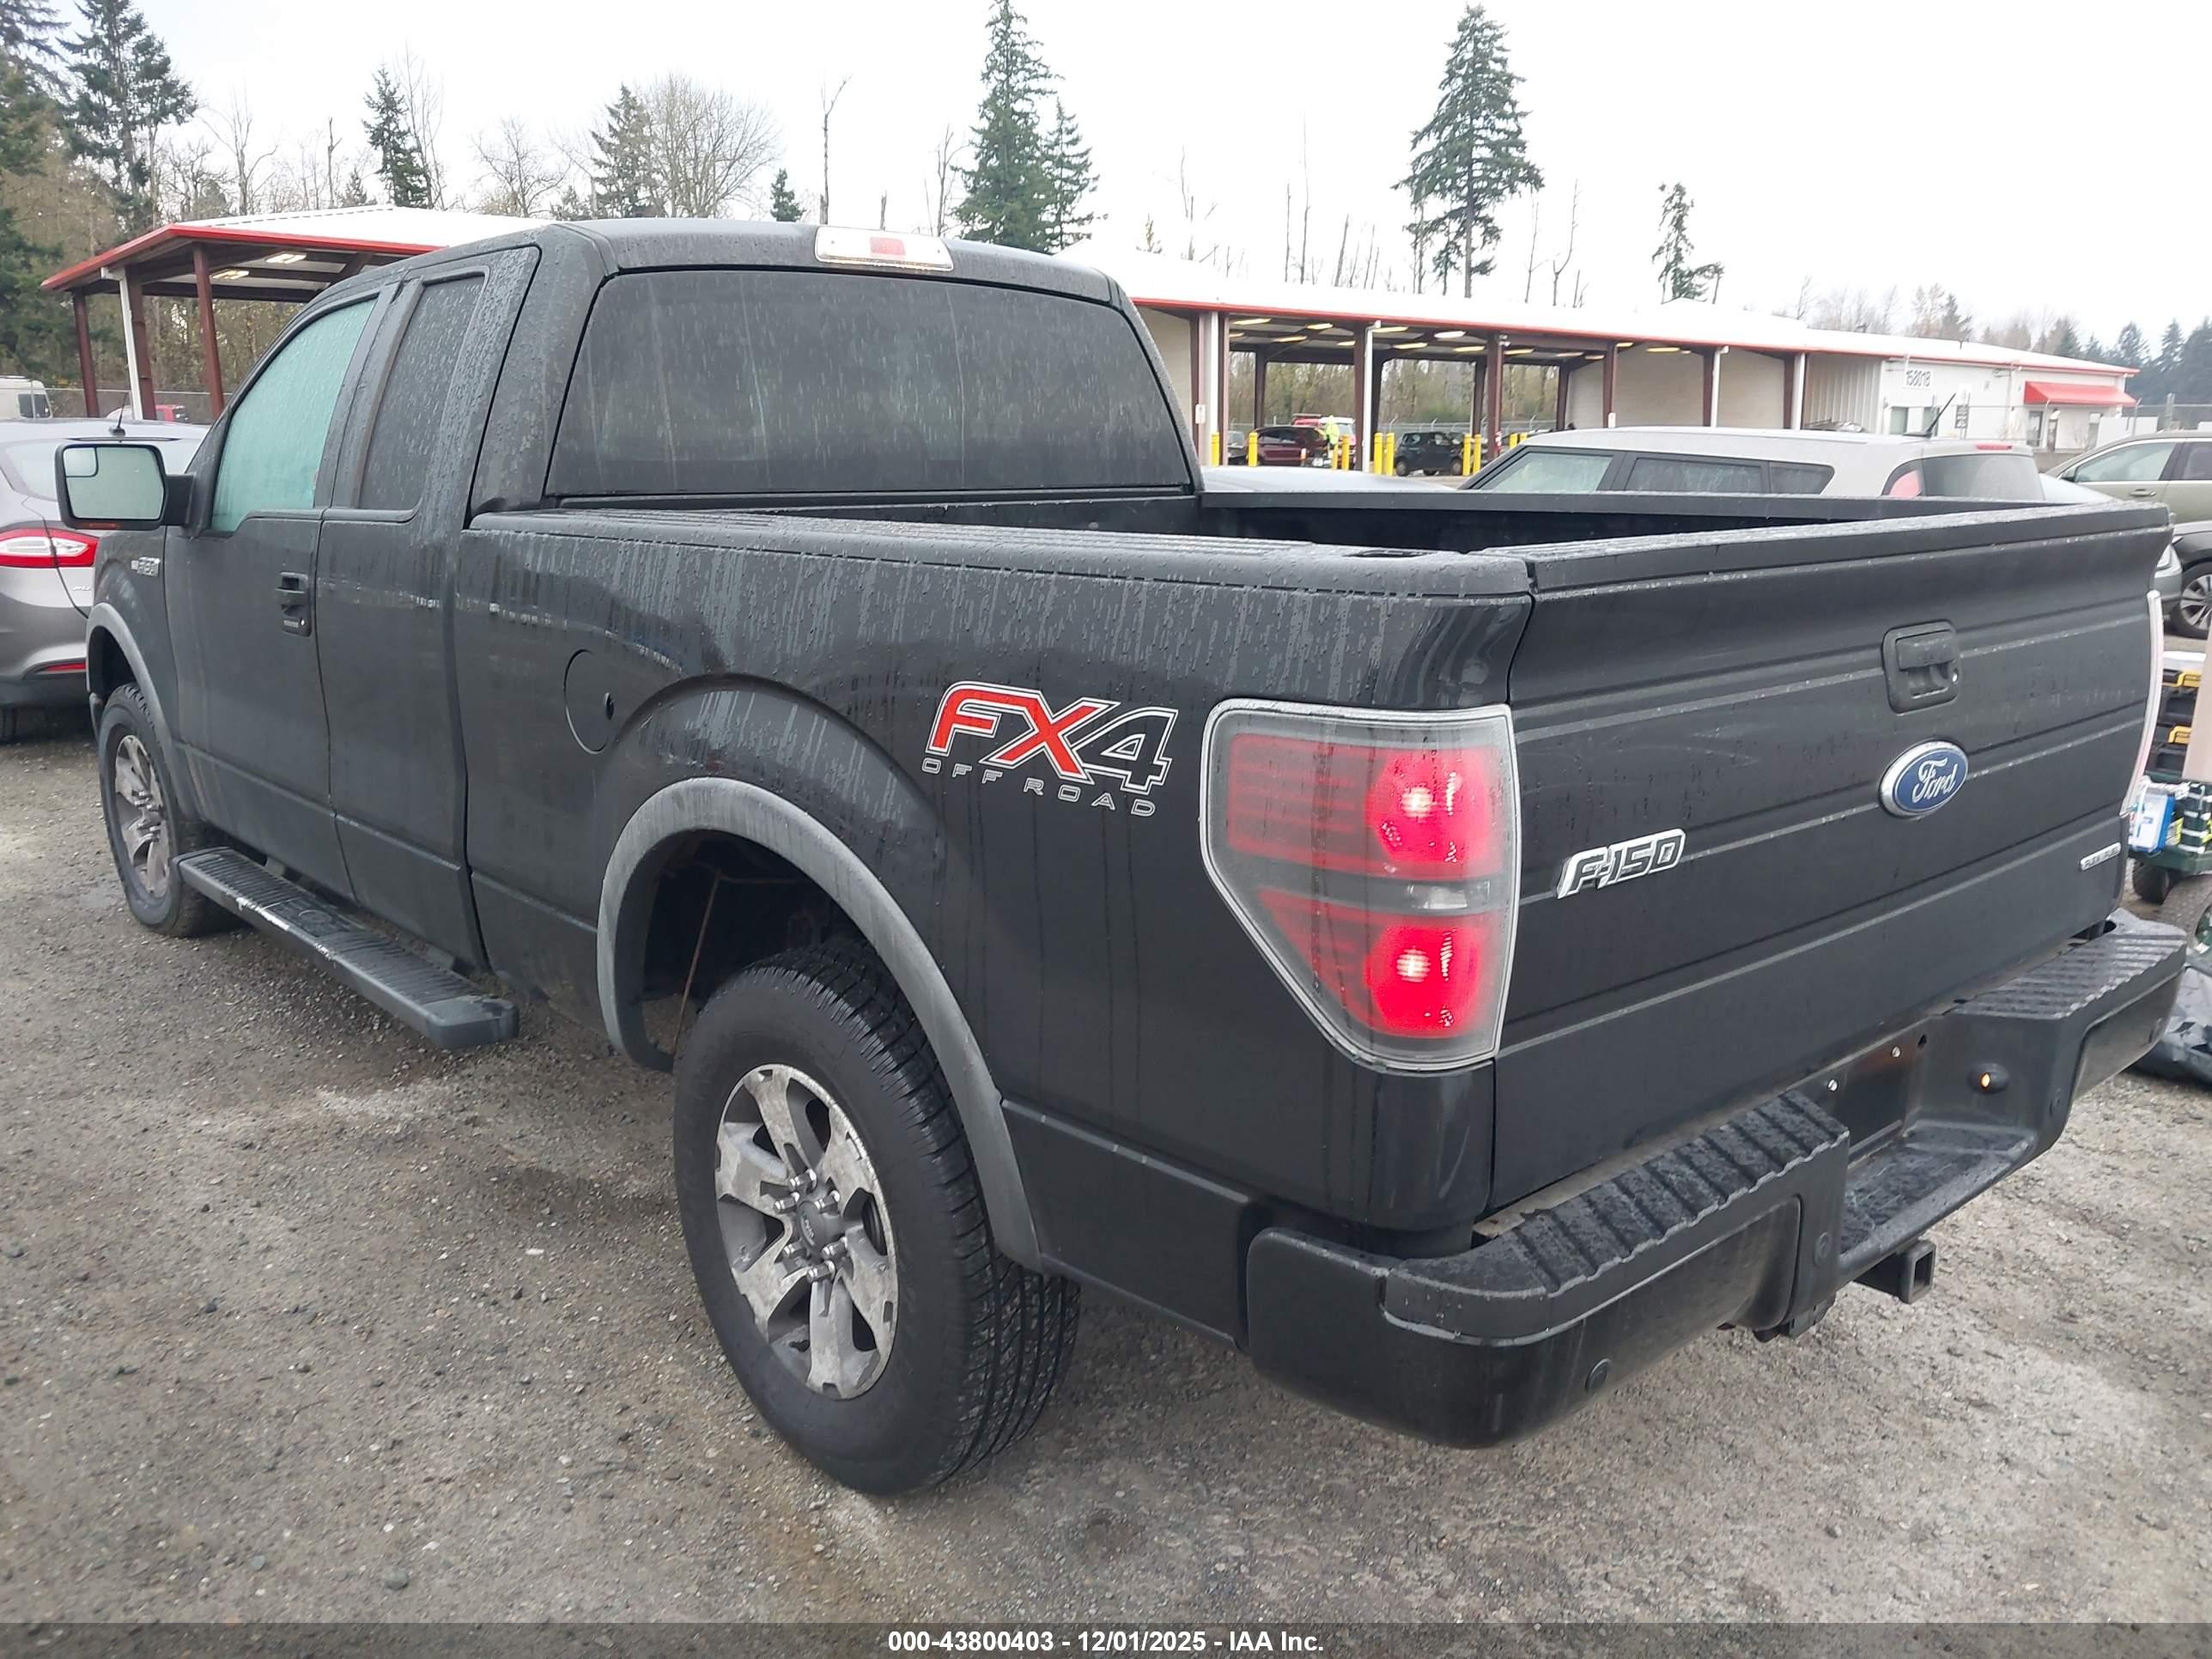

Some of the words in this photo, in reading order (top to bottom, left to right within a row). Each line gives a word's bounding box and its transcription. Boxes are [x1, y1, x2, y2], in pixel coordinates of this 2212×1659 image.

[925, 680, 1179, 794] FX4
[921, 757, 1003, 784] OFF
[1023, 777, 1156, 817] ROAD
[1911, 757, 1958, 804] Ford
[1556, 829, 1686, 899] F-150
